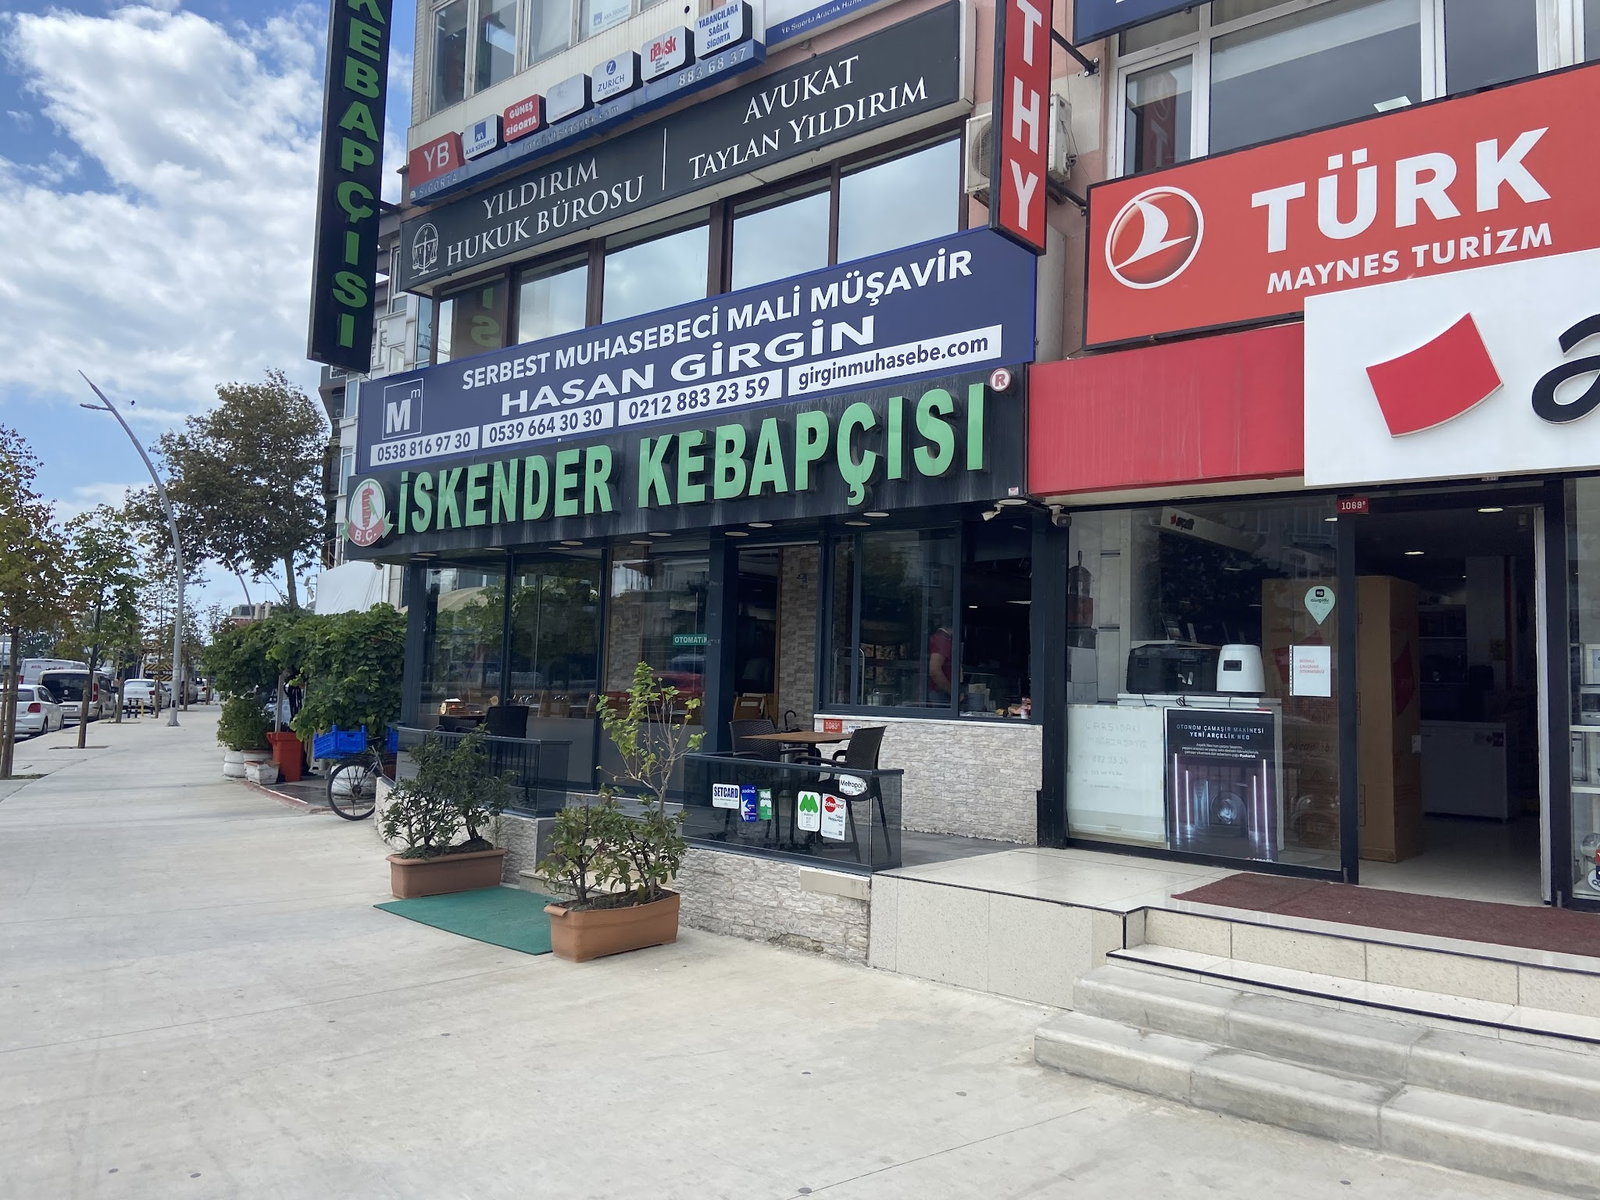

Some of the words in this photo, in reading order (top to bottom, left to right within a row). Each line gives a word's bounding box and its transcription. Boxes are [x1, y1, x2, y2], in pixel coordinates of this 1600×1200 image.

[698, 4, 740, 29] YABANCILARA
[708, 21, 729, 37] SAĞLIK
[706, 32, 731, 49] SİGORTA
[597, 74, 625, 93] ZURICH
[678, 66, 703, 87] 883
[708, 56, 725, 75] 68
[730, 46, 747, 65] 37
[509, 101, 534, 119] GÜNEŞ
[742, 55, 859, 125] AVUKAT
[505, 115, 537, 137] SİGORTA
[688, 130, 780, 181] TAYLAN
[788, 76, 928, 145] YILDIRIM
[1009, 0, 1043, 231] THY
[423, 141, 450, 173] YB
[483, 157, 599, 220] YILDIRIM
[1252, 126, 1552, 254] TÜRK
[446, 215, 531, 266] HUKUK
[536, 174, 645, 232] BÜROSU
[1266, 249, 1399, 295] MAYNES
[1411, 222, 1553, 269] TURİZM
[462, 350, 552, 391] SERBEST
[555, 305, 720, 370] MUHASEBECİ
[728, 285, 801, 332] MALİ
[810, 247, 973, 313] MÜŞAVİR
[501, 363, 656, 417] HASAN
[670, 314, 875, 382] GİRGİN
[798, 334, 988, 391] girginmuhasebe.com
[628, 395, 672, 421] 0212
[676, 387, 711, 412] 883
[716, 381, 739, 405] 23
[743, 375, 770, 399] 59
[489, 422, 525, 443] 0539
[528, 417, 556, 438] 664
[559, 412, 579, 432] 30
[581, 407, 602, 428] 30
[377, 443, 404, 462] 0538
[407, 437, 432, 458] 816
[434, 434, 453, 454] 97
[454, 431, 471, 451] 30
[398, 444, 613, 536] İSKENDER
[638, 382, 985, 508] KEBAPÇISI
[1176, 723, 1202, 731] OTONOM
[1203, 725, 1231, 733] ÇAMAŞIR
[1206, 732, 1235, 740] ARÇELİK
[713, 786, 739, 799] SETCARD
